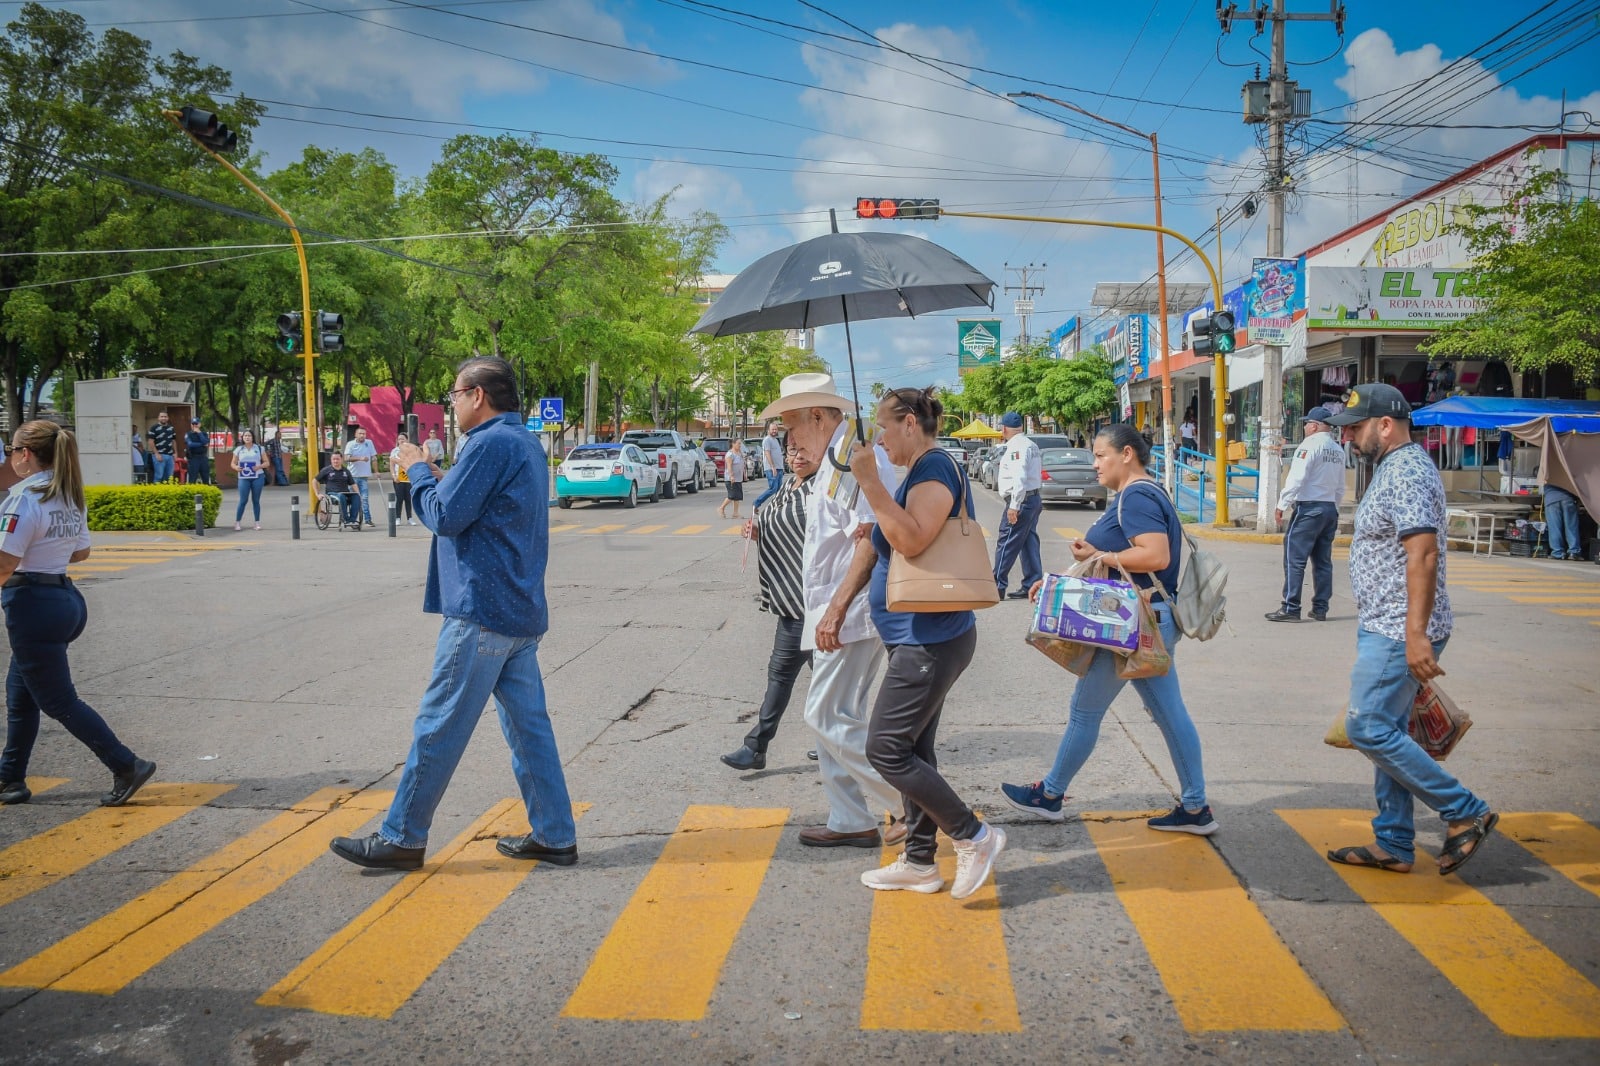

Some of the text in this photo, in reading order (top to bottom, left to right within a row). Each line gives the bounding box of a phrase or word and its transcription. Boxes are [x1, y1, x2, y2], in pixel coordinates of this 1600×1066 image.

[1380, 272, 1422, 297] EL
[1389, 300, 1419, 309] ROPA
[1423, 300, 1454, 309] PARA
[1342, 320, 1383, 328] CABALLERO
[1082, 627, 1096, 639] 5
